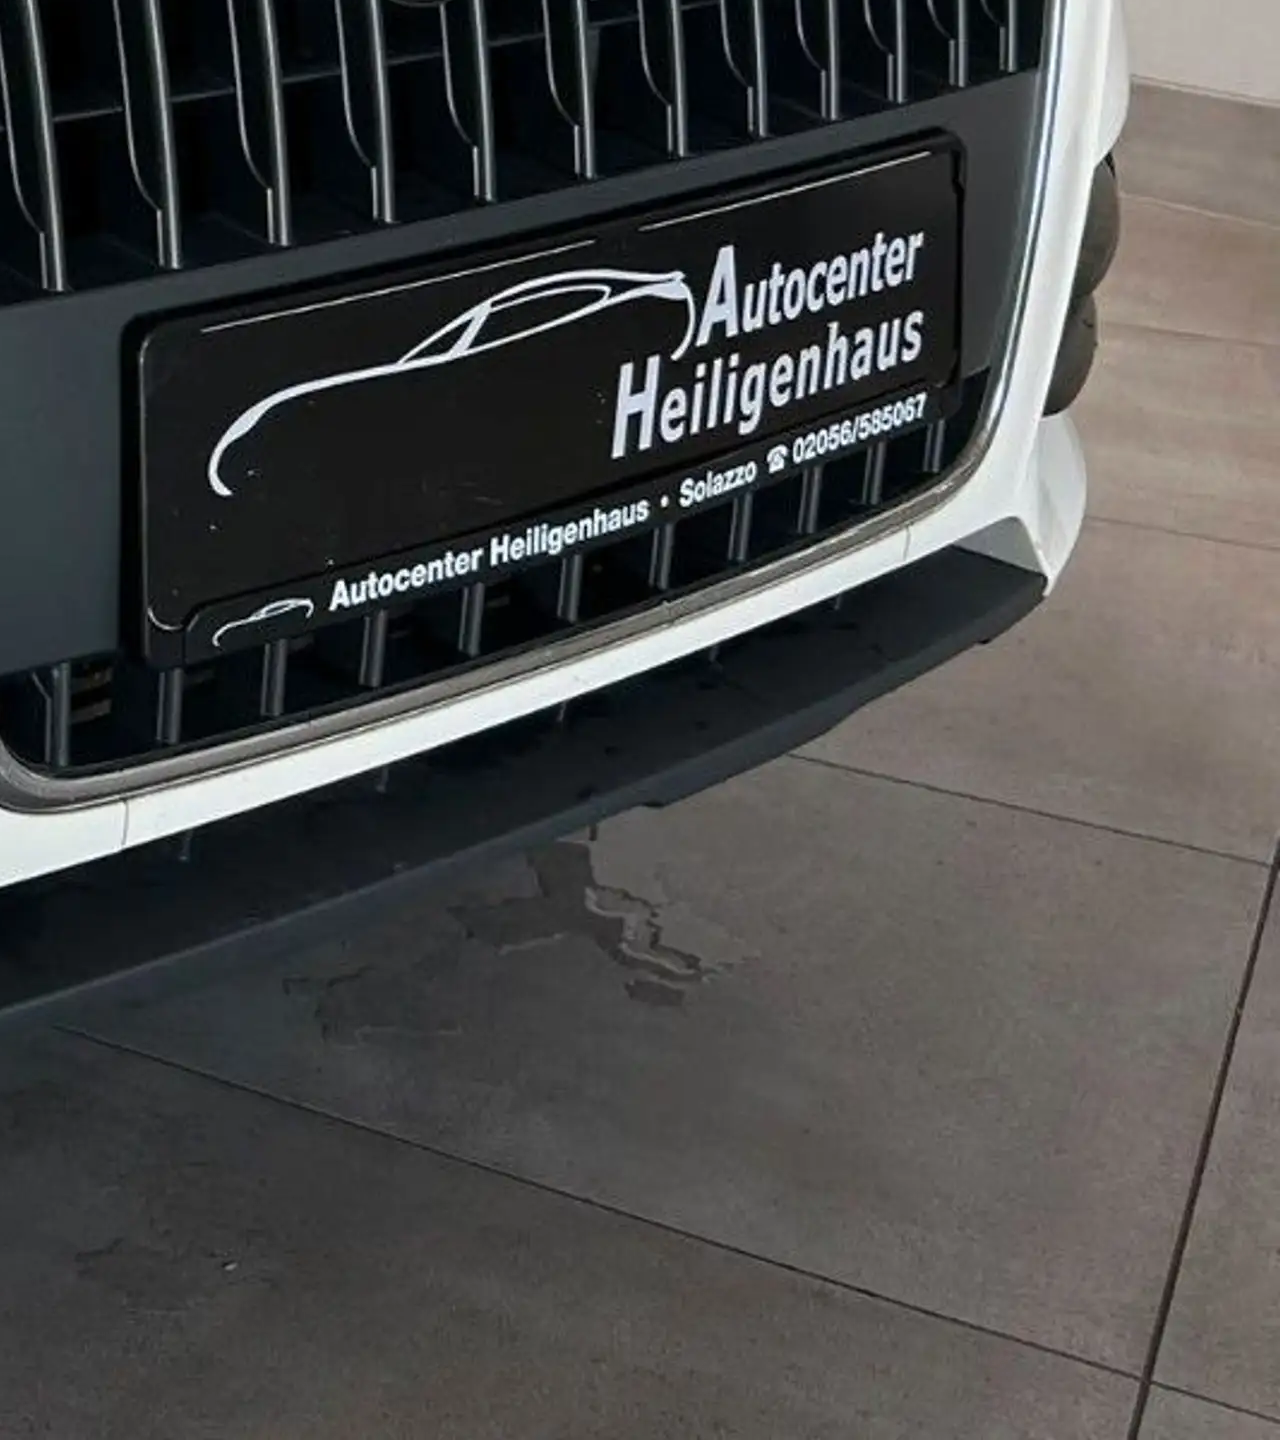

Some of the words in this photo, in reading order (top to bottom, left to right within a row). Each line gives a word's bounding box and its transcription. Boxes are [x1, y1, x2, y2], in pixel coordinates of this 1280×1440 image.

[695, 231, 925, 348] Autocenter
[611, 311, 925, 460] Heiligenhaus
[329, 548, 483, 612] Autocenter
[489, 498, 649, 566] Heiligenhaus
[679, 462, 758, 508] Solazzo
[792, 392, 928, 465] 02056/585067
